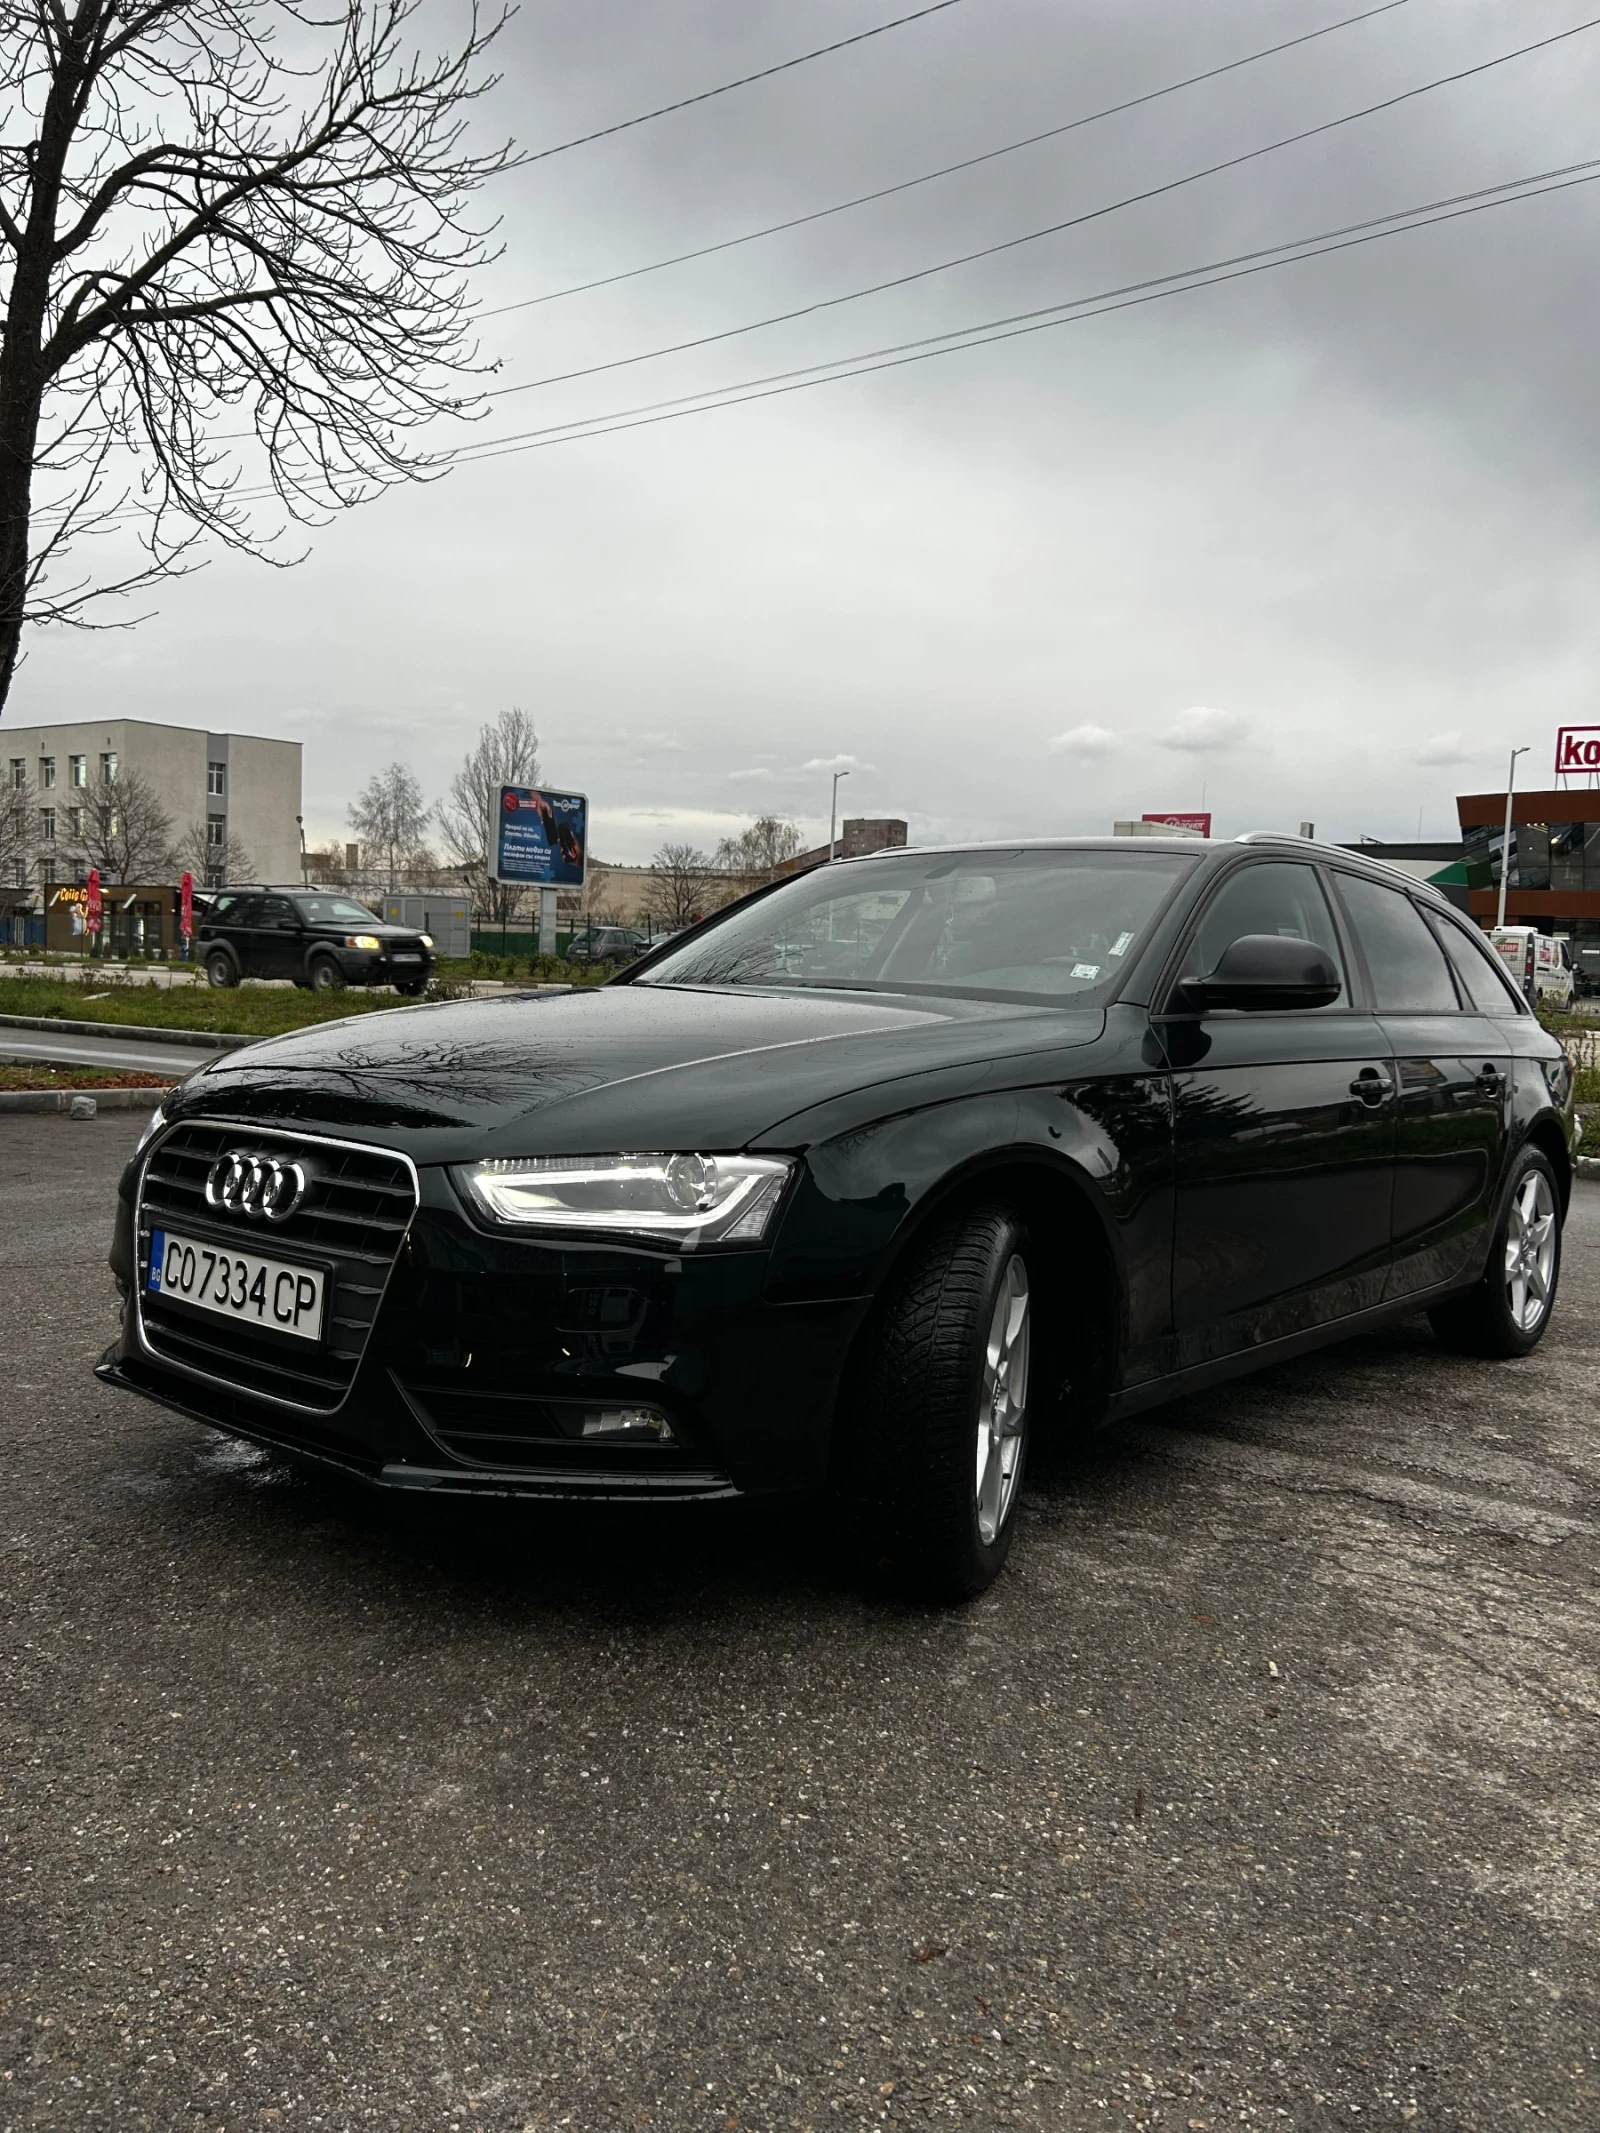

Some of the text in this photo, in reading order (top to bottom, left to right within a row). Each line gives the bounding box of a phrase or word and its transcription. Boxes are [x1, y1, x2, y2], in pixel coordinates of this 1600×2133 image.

[504, 843, 525, 851] Плати
[151, 1267, 162, 1282] BG
[198, 1250, 269, 1317] 7334
[273, 1270, 317, 1327] CP
